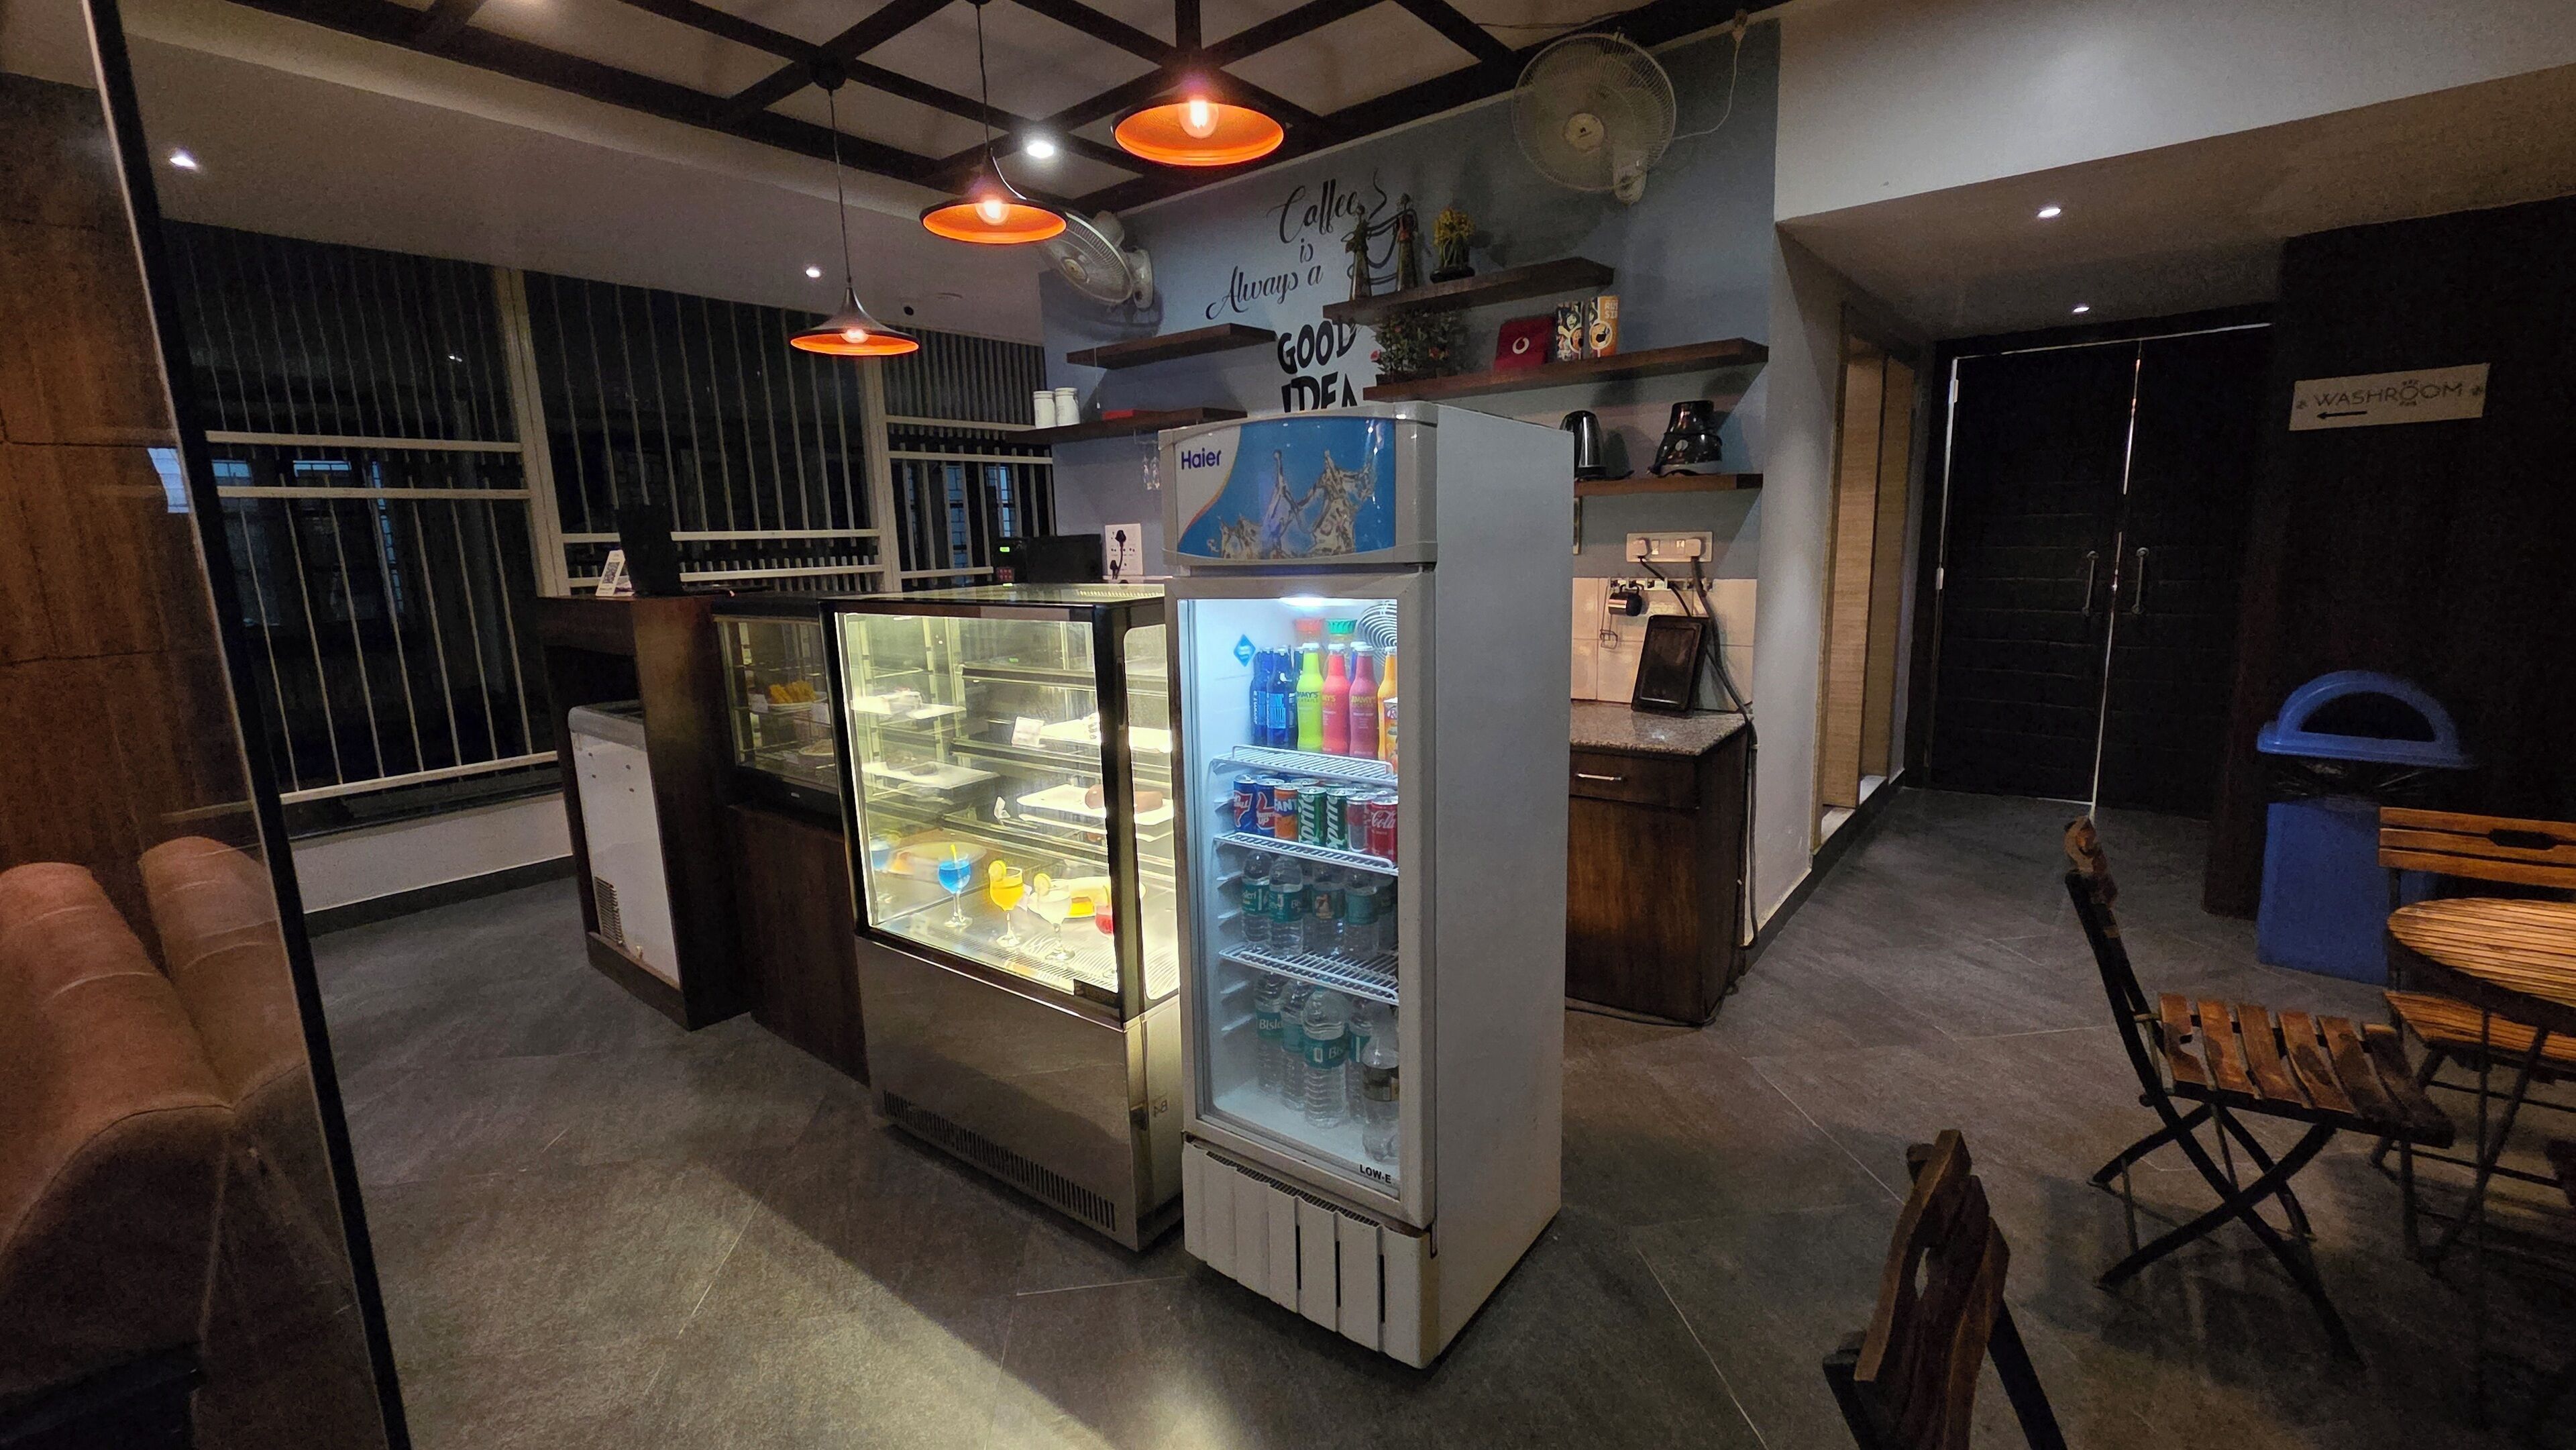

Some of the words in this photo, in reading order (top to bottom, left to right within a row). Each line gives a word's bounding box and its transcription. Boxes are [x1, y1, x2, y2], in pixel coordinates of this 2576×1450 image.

[1266, 178, 1358, 244] Coffee
[1299, 238, 1313, 263] is
[1205, 266, 1299, 319] Always
[1307, 265, 1323, 287] a
[1277, 321, 1357, 374] GOOD
[1281, 372, 1358, 413] IDEA
[2314, 380, 2463, 407] WASHROOM
[1181, 448, 1222, 470] Haier
[1360, 1164, 1392, 1184] LOW-E
